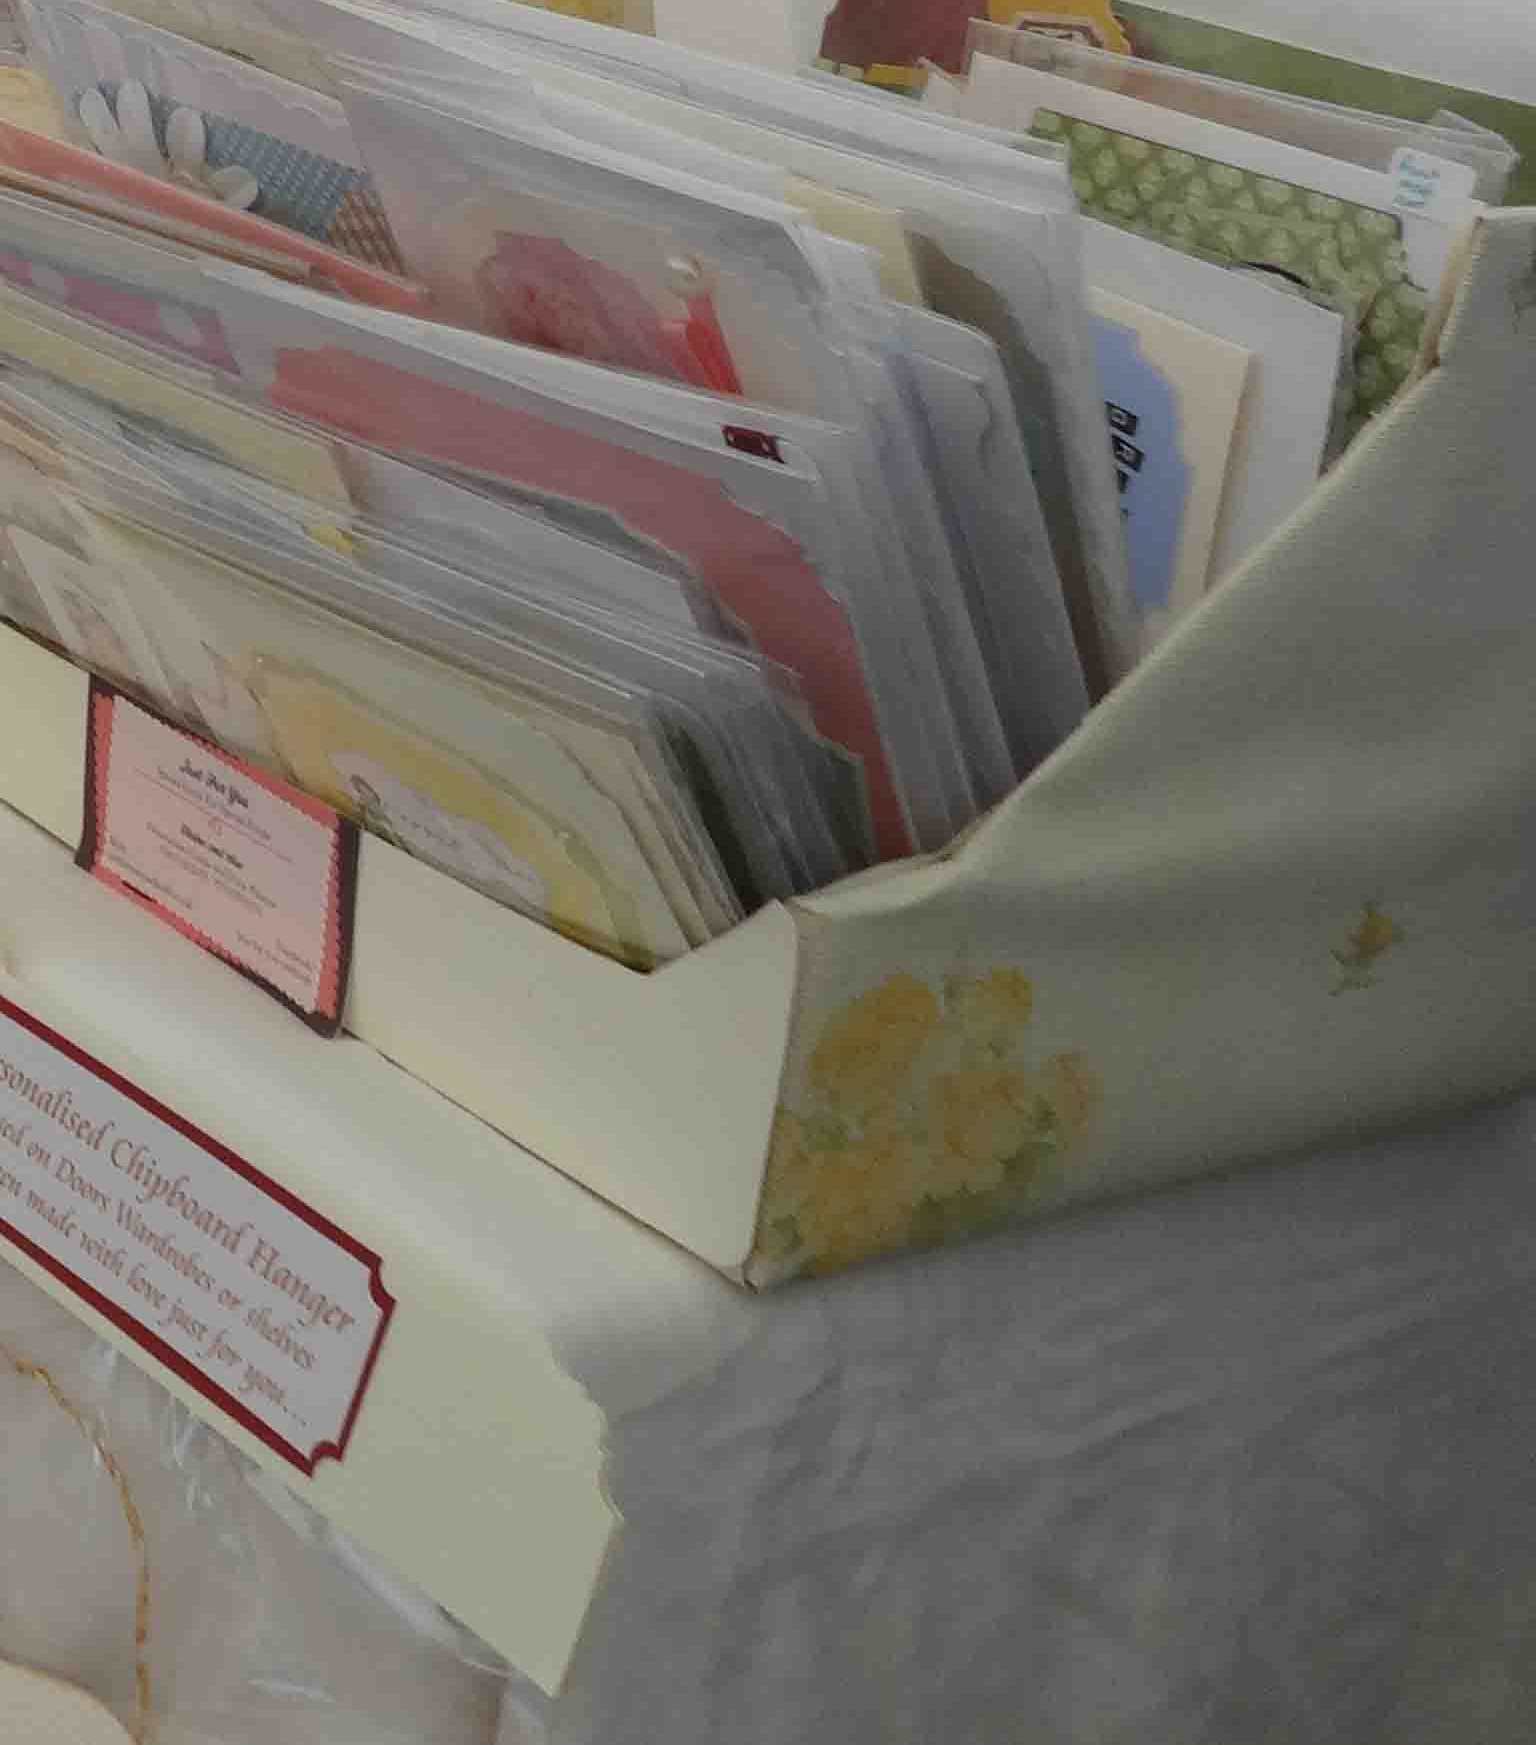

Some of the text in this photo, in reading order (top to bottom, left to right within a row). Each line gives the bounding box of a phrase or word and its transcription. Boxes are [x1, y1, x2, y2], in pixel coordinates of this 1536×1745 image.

[27, 1188, 78, 1239] made
[79, 1228, 129, 1278] with
[128, 1261, 166, 1310] love
[55, 1156, 111, 1213] Doors
[116, 1198, 216, 1292] Wardrobes
[243, 1306, 317, 1370] shelves
[110, 1138, 256, 1255] Chipboard
[247, 1237, 356, 1335] Hanger
